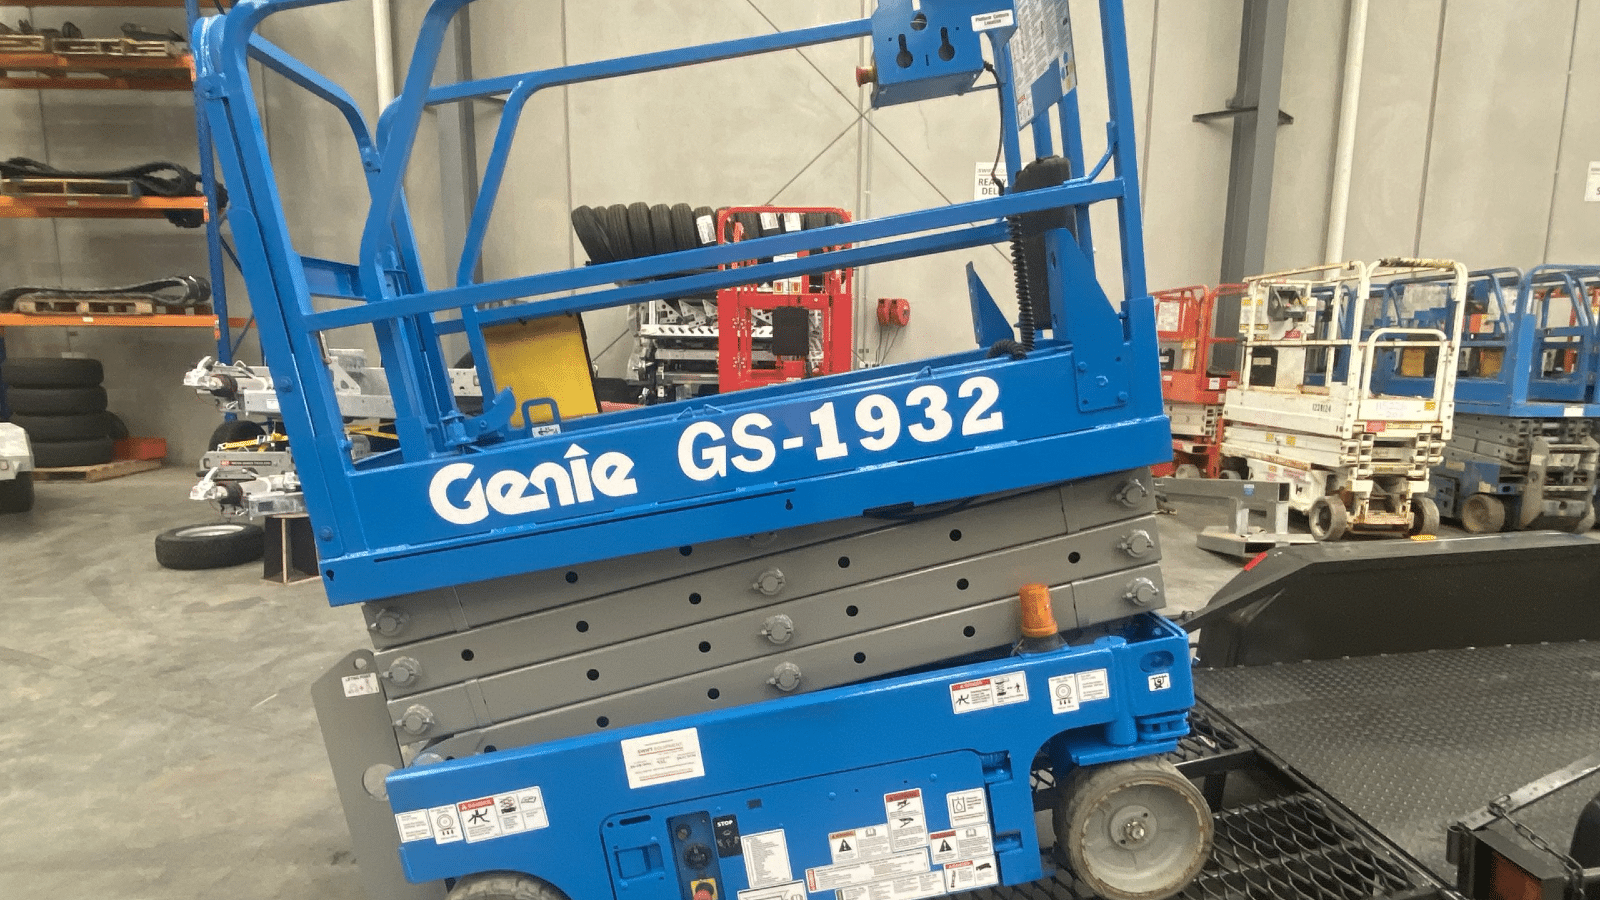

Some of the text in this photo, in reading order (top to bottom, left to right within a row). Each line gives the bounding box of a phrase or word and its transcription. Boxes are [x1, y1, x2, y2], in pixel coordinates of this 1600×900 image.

[978, 178, 1006, 186] REAY
[981, 187, 999, 195] DEL
[678, 376, 1003, 481] GS-1932
[429, 443, 638, 525] Genie
[716, 819, 733, 828] STOP
